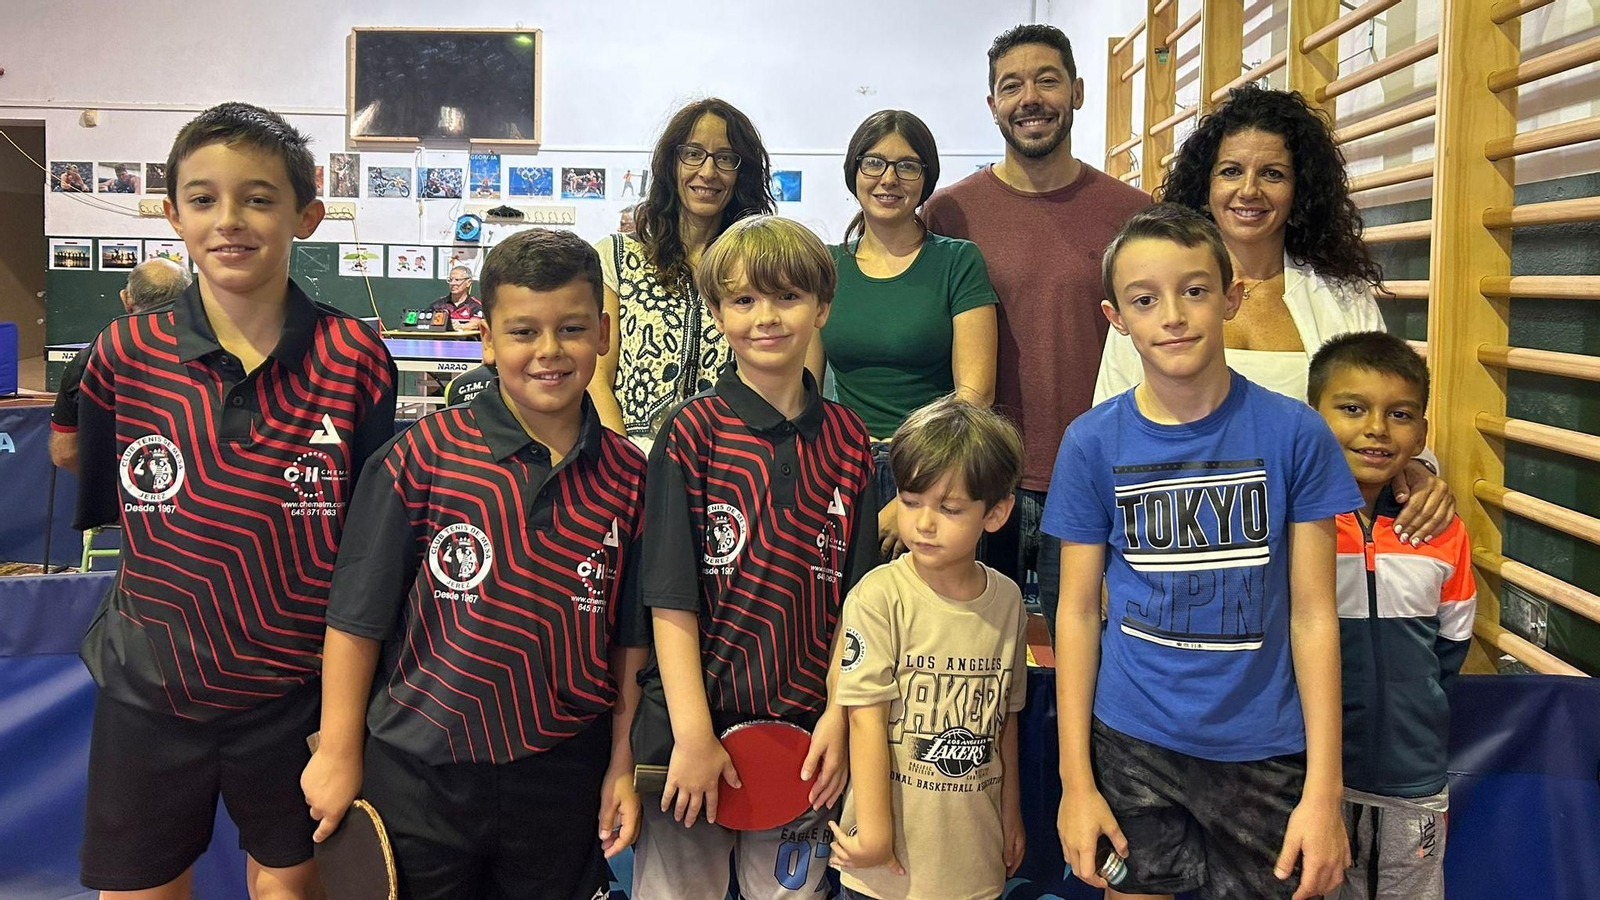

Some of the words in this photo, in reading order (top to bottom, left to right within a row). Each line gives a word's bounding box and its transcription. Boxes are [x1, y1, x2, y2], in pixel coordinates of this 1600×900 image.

[62, 352, 77, 360] NA
[463, 391, 481, 402] RU
[121, 446, 136, 468] CLUB
[136, 436, 162, 446] TENIS
[172, 447, 184, 470] MESA
[138, 492, 167, 501] JEREZ
[124, 503, 155, 513] Desde
[157, 504, 177, 514] 1967
[1115, 481, 1270, 549] TOKYO
[726, 505, 737, 515] DE
[736, 513, 746, 535] MESA
[430, 533, 445, 555] CLUB
[444, 525, 468, 534] TENIS
[470, 527, 480, 537] DE
[480, 536, 491, 560] MESA
[446, 580, 471, 589] JEREZ
[433, 589, 459, 601] Desde
[460, 593, 478, 604] 1967
[1125, 566, 1266, 635] JPN
[905, 654, 936, 669] LOS
[946, 657, 1002, 672] ANGELES
[960, 738, 987, 746] ANGELES
[920, 738, 986, 766] LAKERS
[916, 779, 974, 793] BASKETBALL
[780, 827, 819, 841] EAGLE
